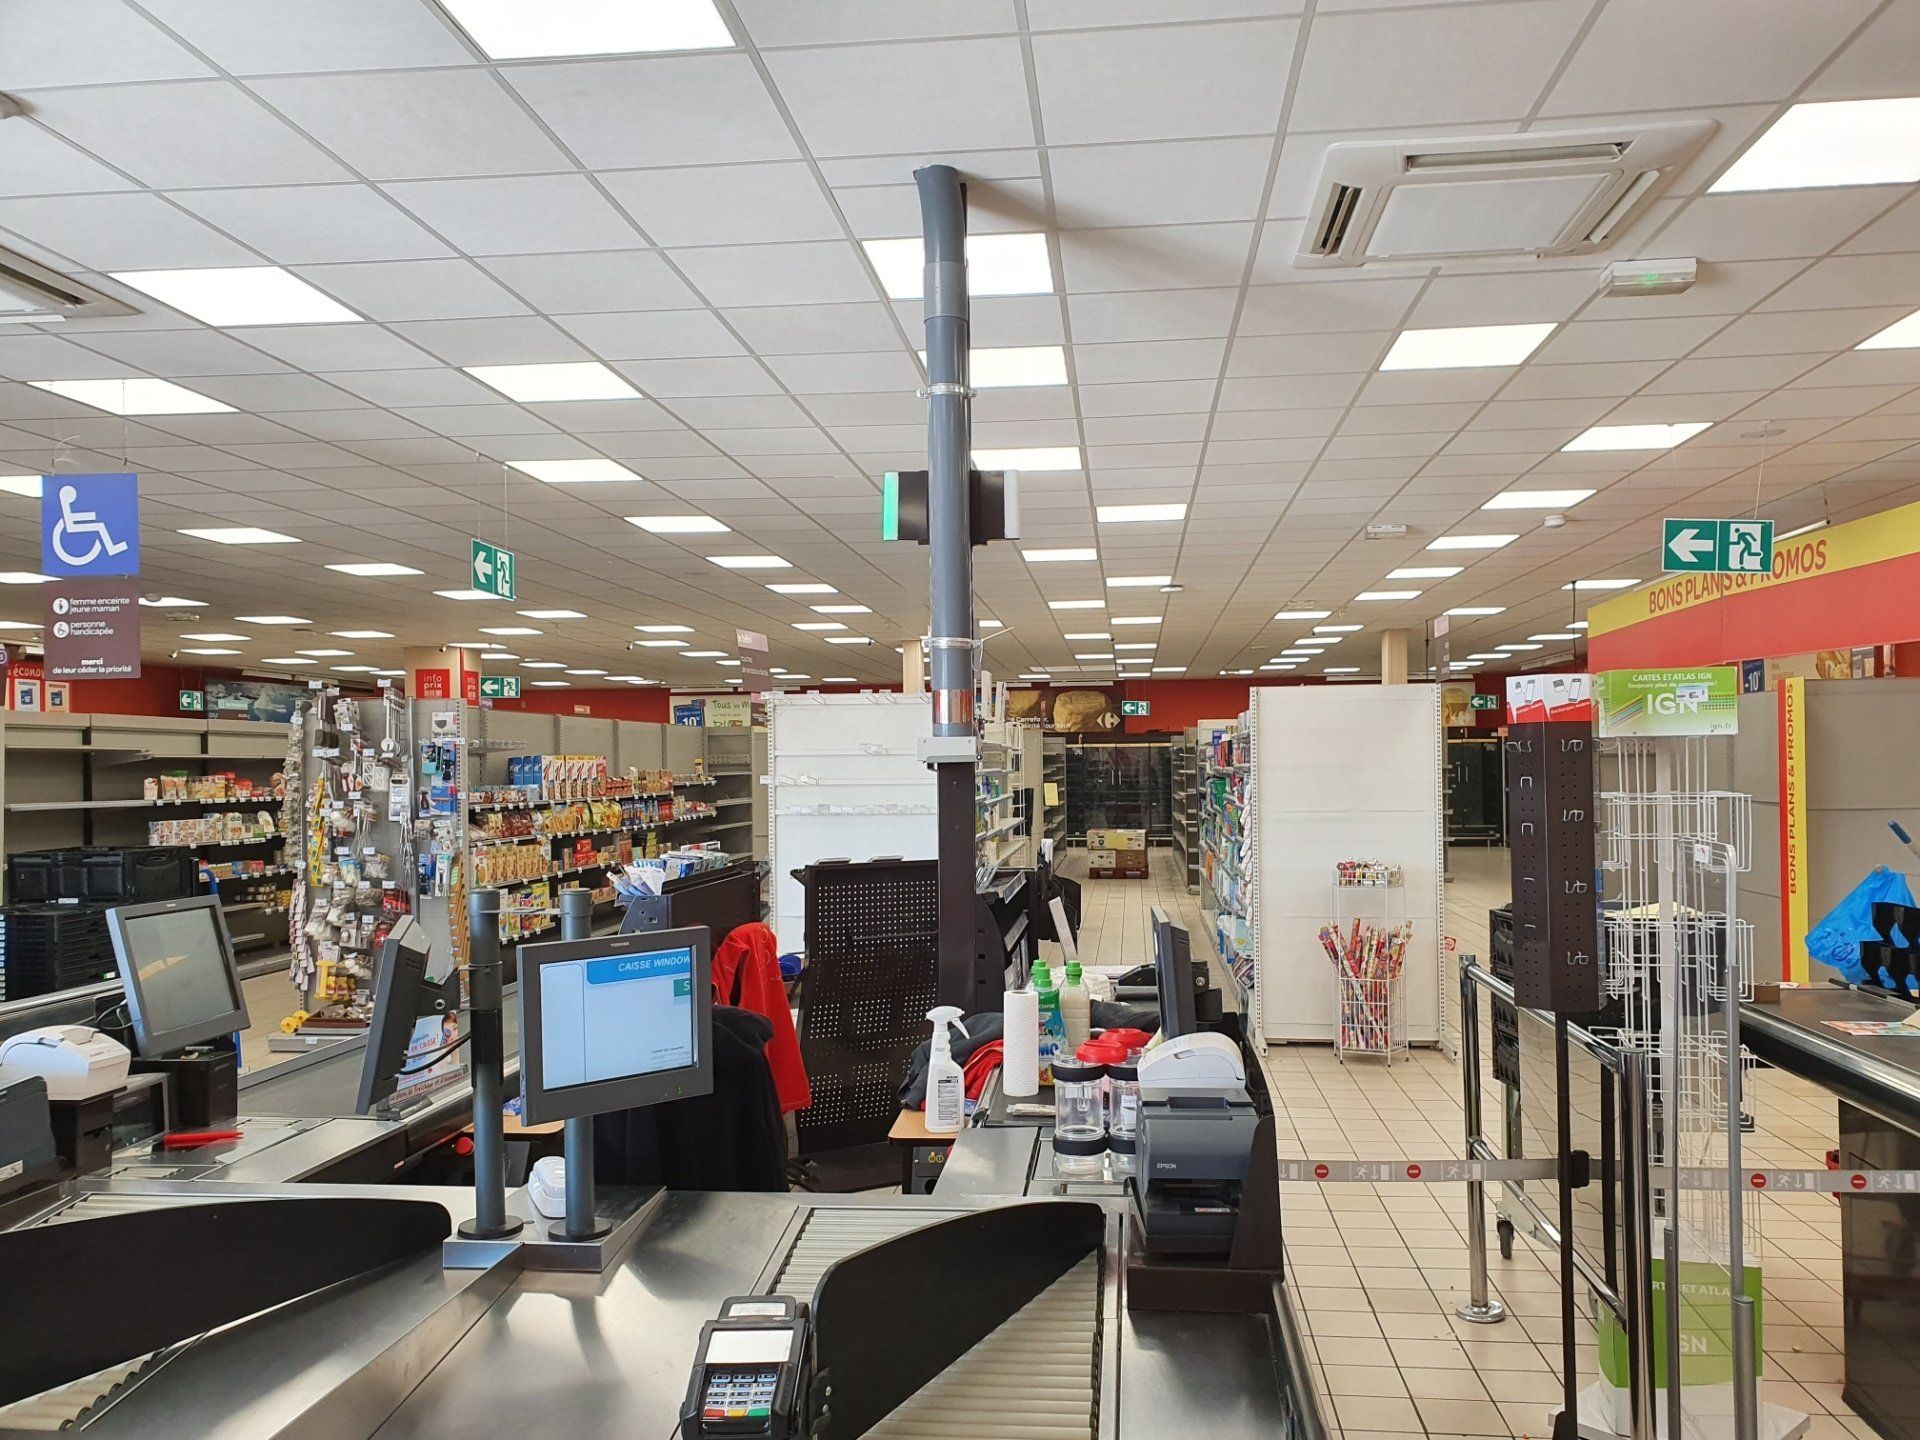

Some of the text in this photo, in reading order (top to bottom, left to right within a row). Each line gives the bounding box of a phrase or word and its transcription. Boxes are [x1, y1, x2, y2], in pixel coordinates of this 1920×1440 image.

[97, 596, 130, 605] enceinte
[1649, 581, 1683, 614] BONS
[70, 605, 120, 614] jeune maman
[70, 621, 114, 636] personne handicapée
[81, 657, 104, 666] merci
[63, 666, 77, 674] leur
[77, 666, 98, 674] céder
[106, 665, 132, 675] priorité
[423, 674, 443, 682] info
[1632, 673, 1661, 682] CARTES
[1671, 672, 1696, 680] ATLAS
[1697, 671, 1713, 680] IGN
[423, 682, 443, 690] prix
[1710, 721, 1732, 730] ign.fr
[1786, 683, 1797, 894] BONS PLANS & PROMOS
[618, 959, 652, 972] CAISSE
[1682, 1284, 1731, 1297] ET ATLA
